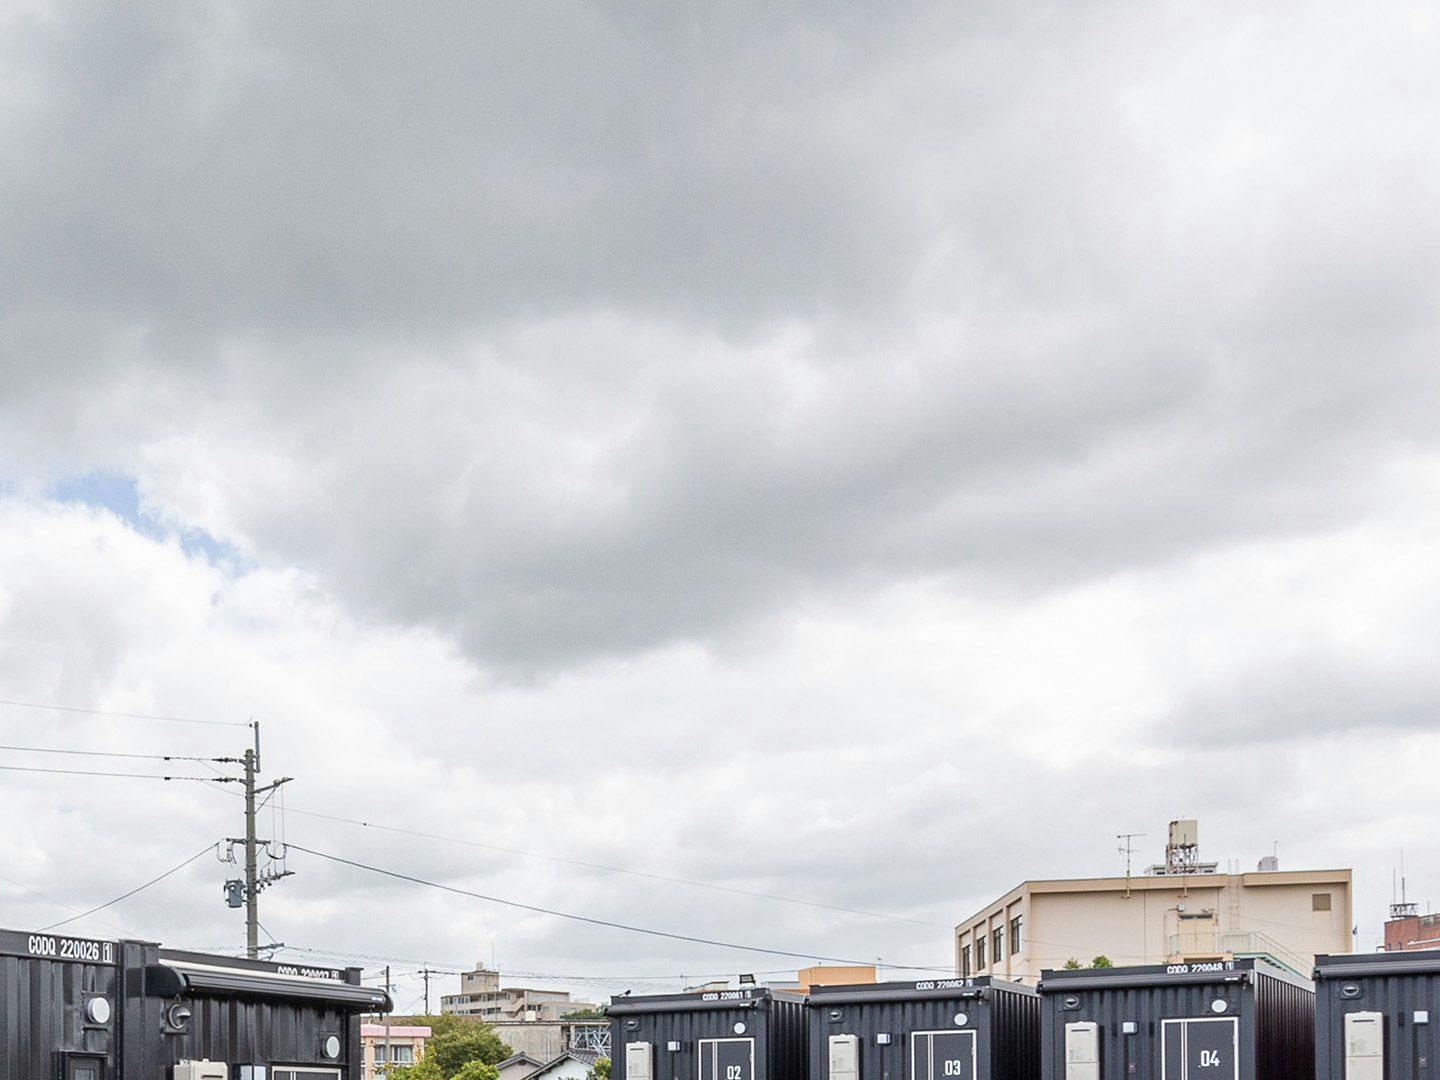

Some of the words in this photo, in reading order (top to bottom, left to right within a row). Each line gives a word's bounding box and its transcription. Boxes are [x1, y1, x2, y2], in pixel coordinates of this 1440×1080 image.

[27, 935, 56, 956] CODQ
[60, 939, 99, 960] 220026
[1200, 1050, 1220, 1067] 04
[727, 1065, 742, 1080] 02
[944, 1060, 961, 1076] 03
